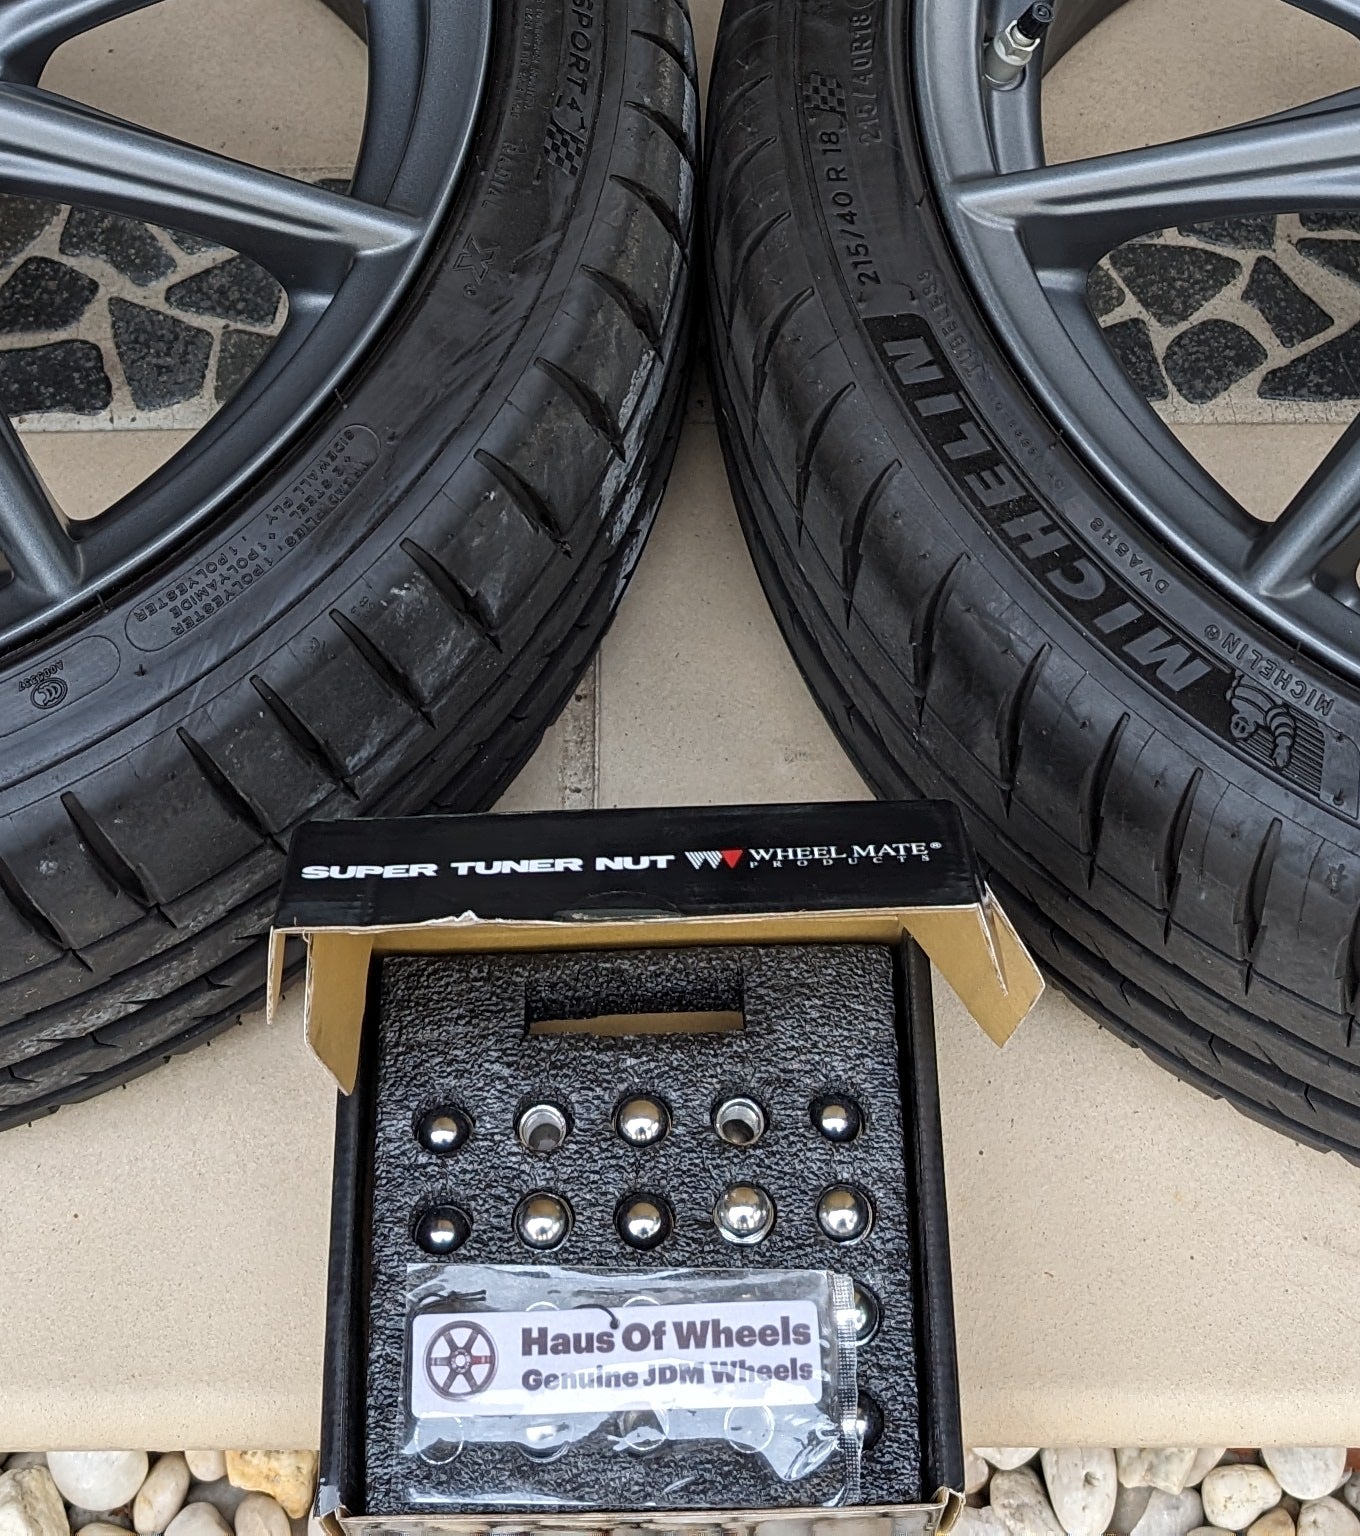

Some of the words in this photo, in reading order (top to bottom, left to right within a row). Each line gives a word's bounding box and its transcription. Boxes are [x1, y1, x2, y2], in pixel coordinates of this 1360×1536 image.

[565, 96, 584, 109] 4
[817, 129, 845, 155] 18
[822, 165, 850, 180] R
[828, 193, 885, 286] 215/40
[880, 333, 1213, 697] MICHELIN
[132, 551, 230, 624] POLYESTER
[166, 547, 260, 619] POLYAMIDE
[168, 563, 266, 637] POLYESTER
[301, 863, 439, 879] SUPER
[450, 857, 584, 876] TUNER
[595, 855, 676, 870] NUT
[748, 846, 847, 861] WHEEL
[750, 854, 930, 869] PRODUCTS
[521, 1326, 616, 1356] Haus
[621, 1320, 667, 1352] Of
[672, 1315, 812, 1349] Wheels
[521, 1364, 639, 1392] Genuine
[643, 1361, 706, 1387] JDM
[711, 1357, 813, 1384] Wheels
